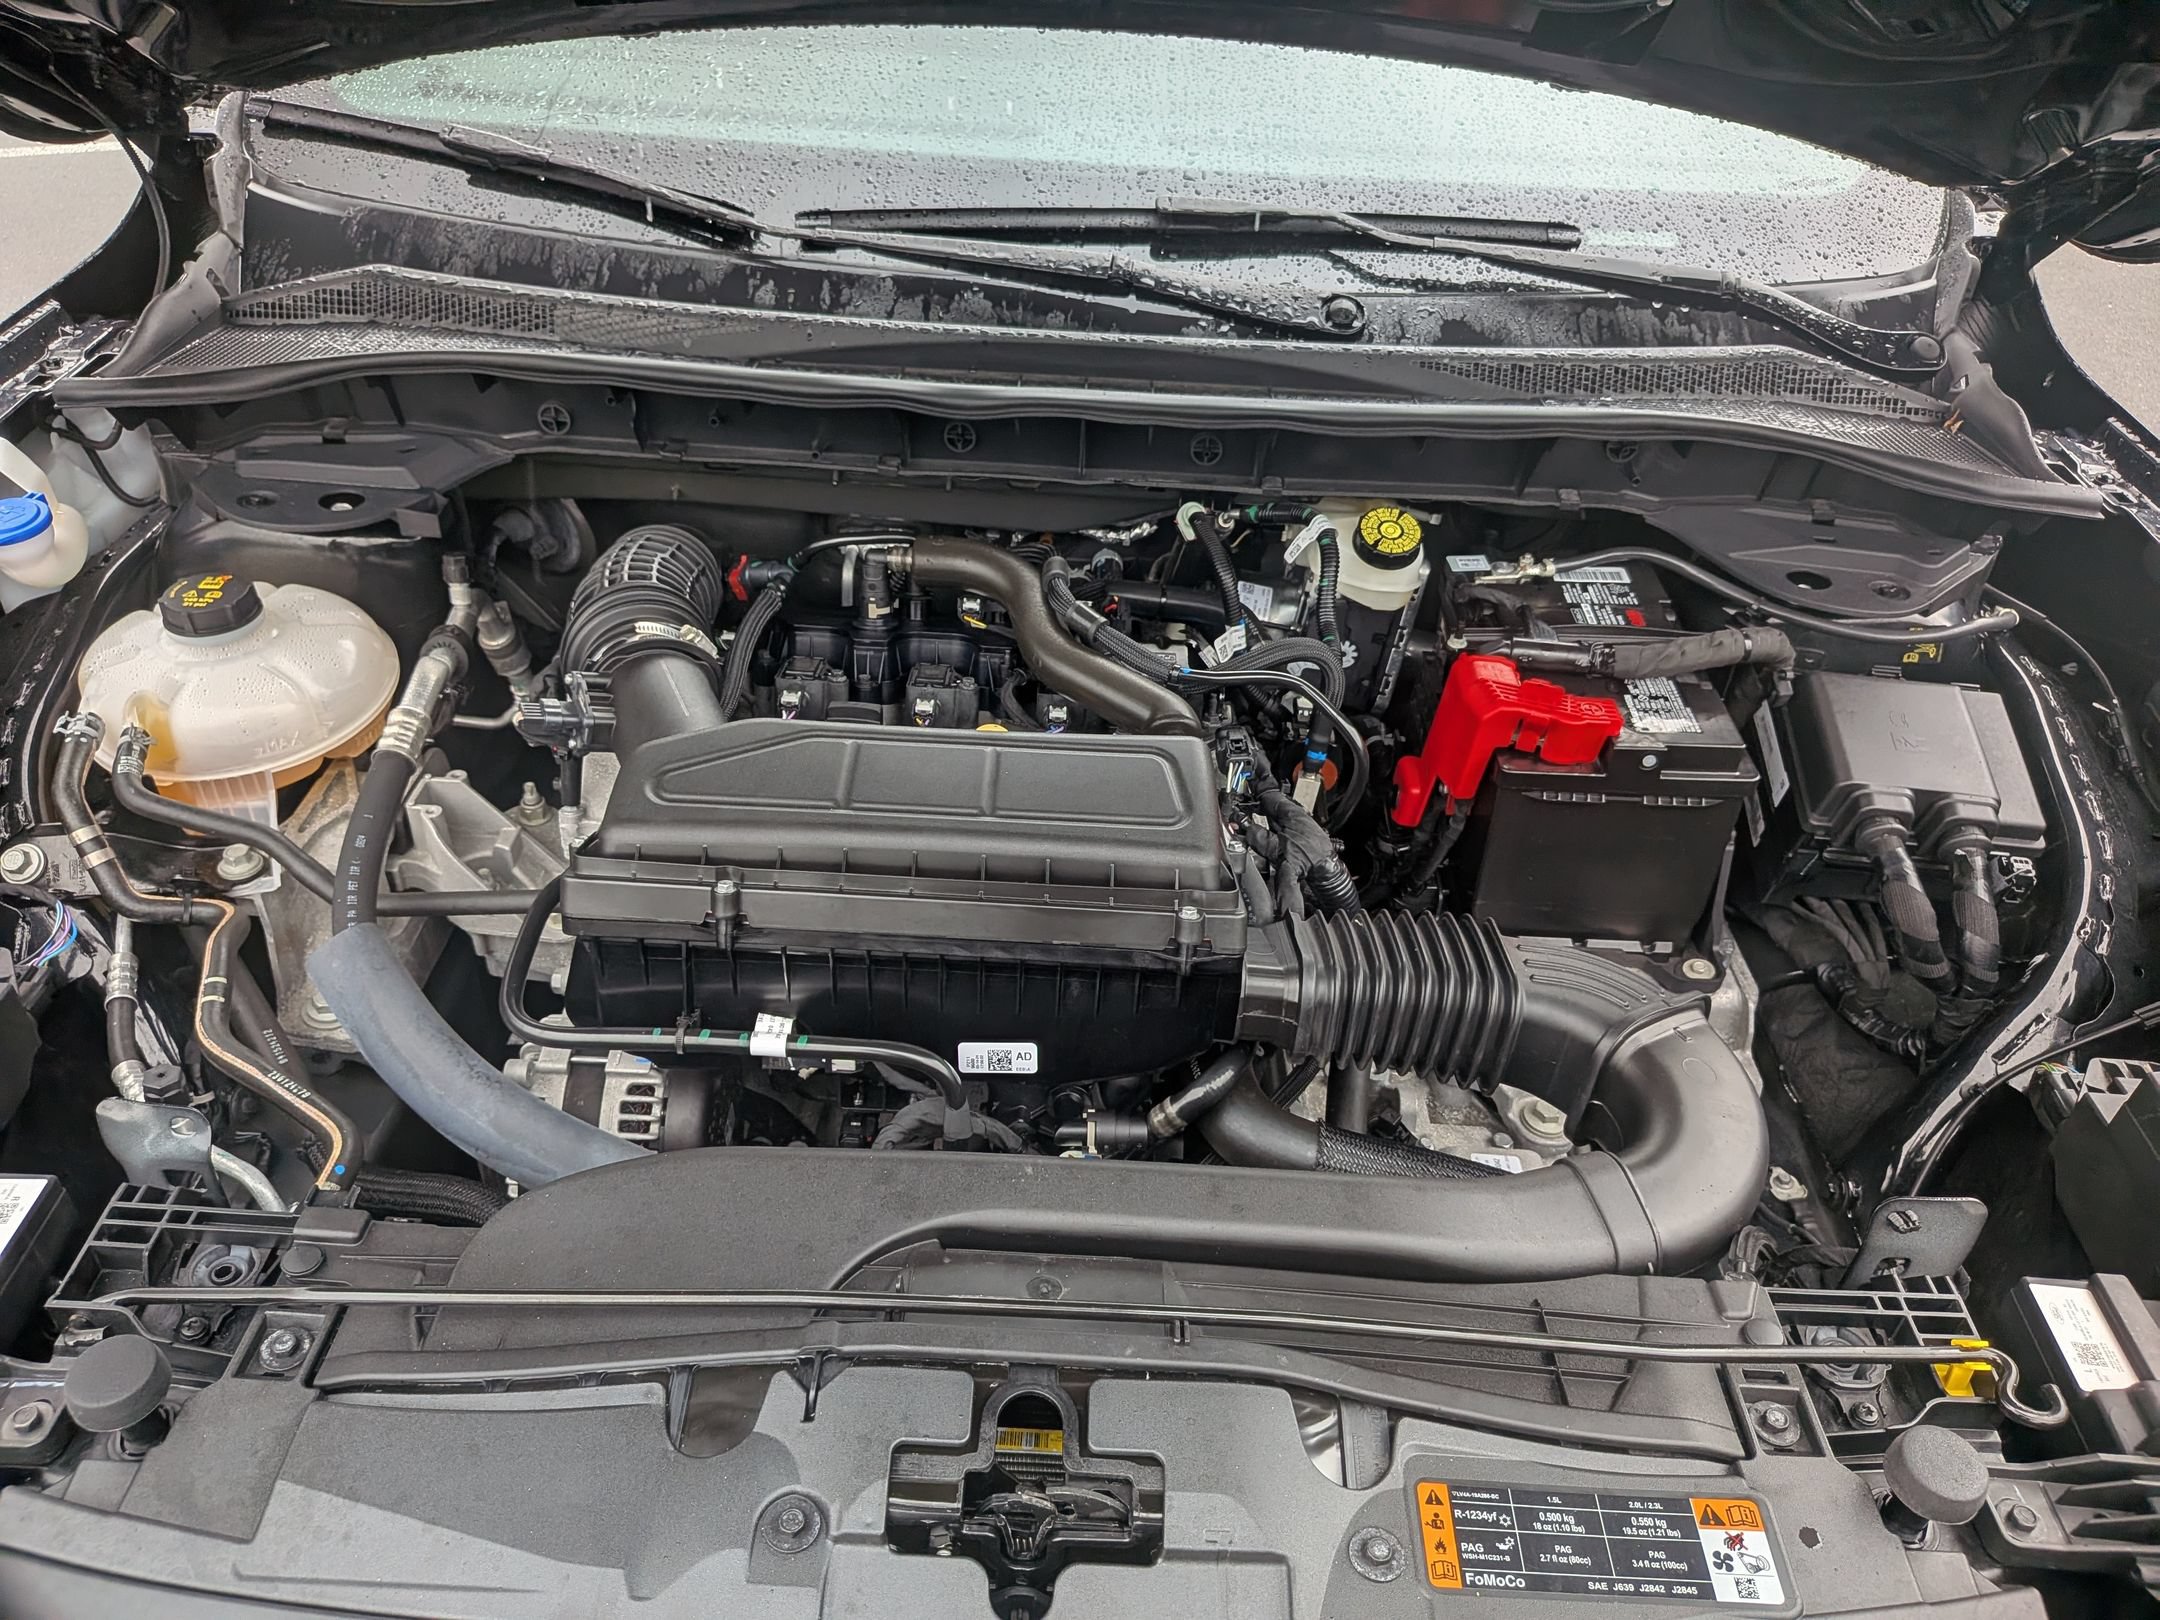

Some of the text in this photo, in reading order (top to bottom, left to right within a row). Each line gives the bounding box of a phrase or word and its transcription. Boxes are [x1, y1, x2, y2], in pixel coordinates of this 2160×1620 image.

[1016, 1052, 1032, 1061] AD
[1547, 1496, 1562, 1504] 1.5L
[1628, 1501, 1643, 1509] 2.0L
[1648, 1502, 1664, 1510] 2.3L
[1454, 1509, 1497, 1523] R-1234yf
[1539, 1511, 1575, 1525] 0.500 kg
[1533, 1522, 1542, 1530] 18
[1553, 1523, 1571, 1533] (1.10
[1571, 1525, 1586, 1534] lbs)
[1631, 1516, 1667, 1529] 0.550 kg
[1622, 1526, 1638, 1535] 19.5
[1648, 1527, 1666, 1537] (1.21
[1666, 1529, 1681, 1539] lbs)
[1461, 1542, 1485, 1553] PAG
[1554, 1544, 1573, 1554] PAG
[1540, 1553, 1551, 1562] 2.7
[1648, 1550, 1667, 1559] PAG
[1632, 1559, 1643, 1568] 3.4
[1651, 1561, 1660, 1569] oz
[1661, 1560, 1688, 1572] (100cc)
[1465, 1572, 1526, 1588] FoMoCo
[1588, 1581, 1698, 1595] SAE J639 J2842 J2845
